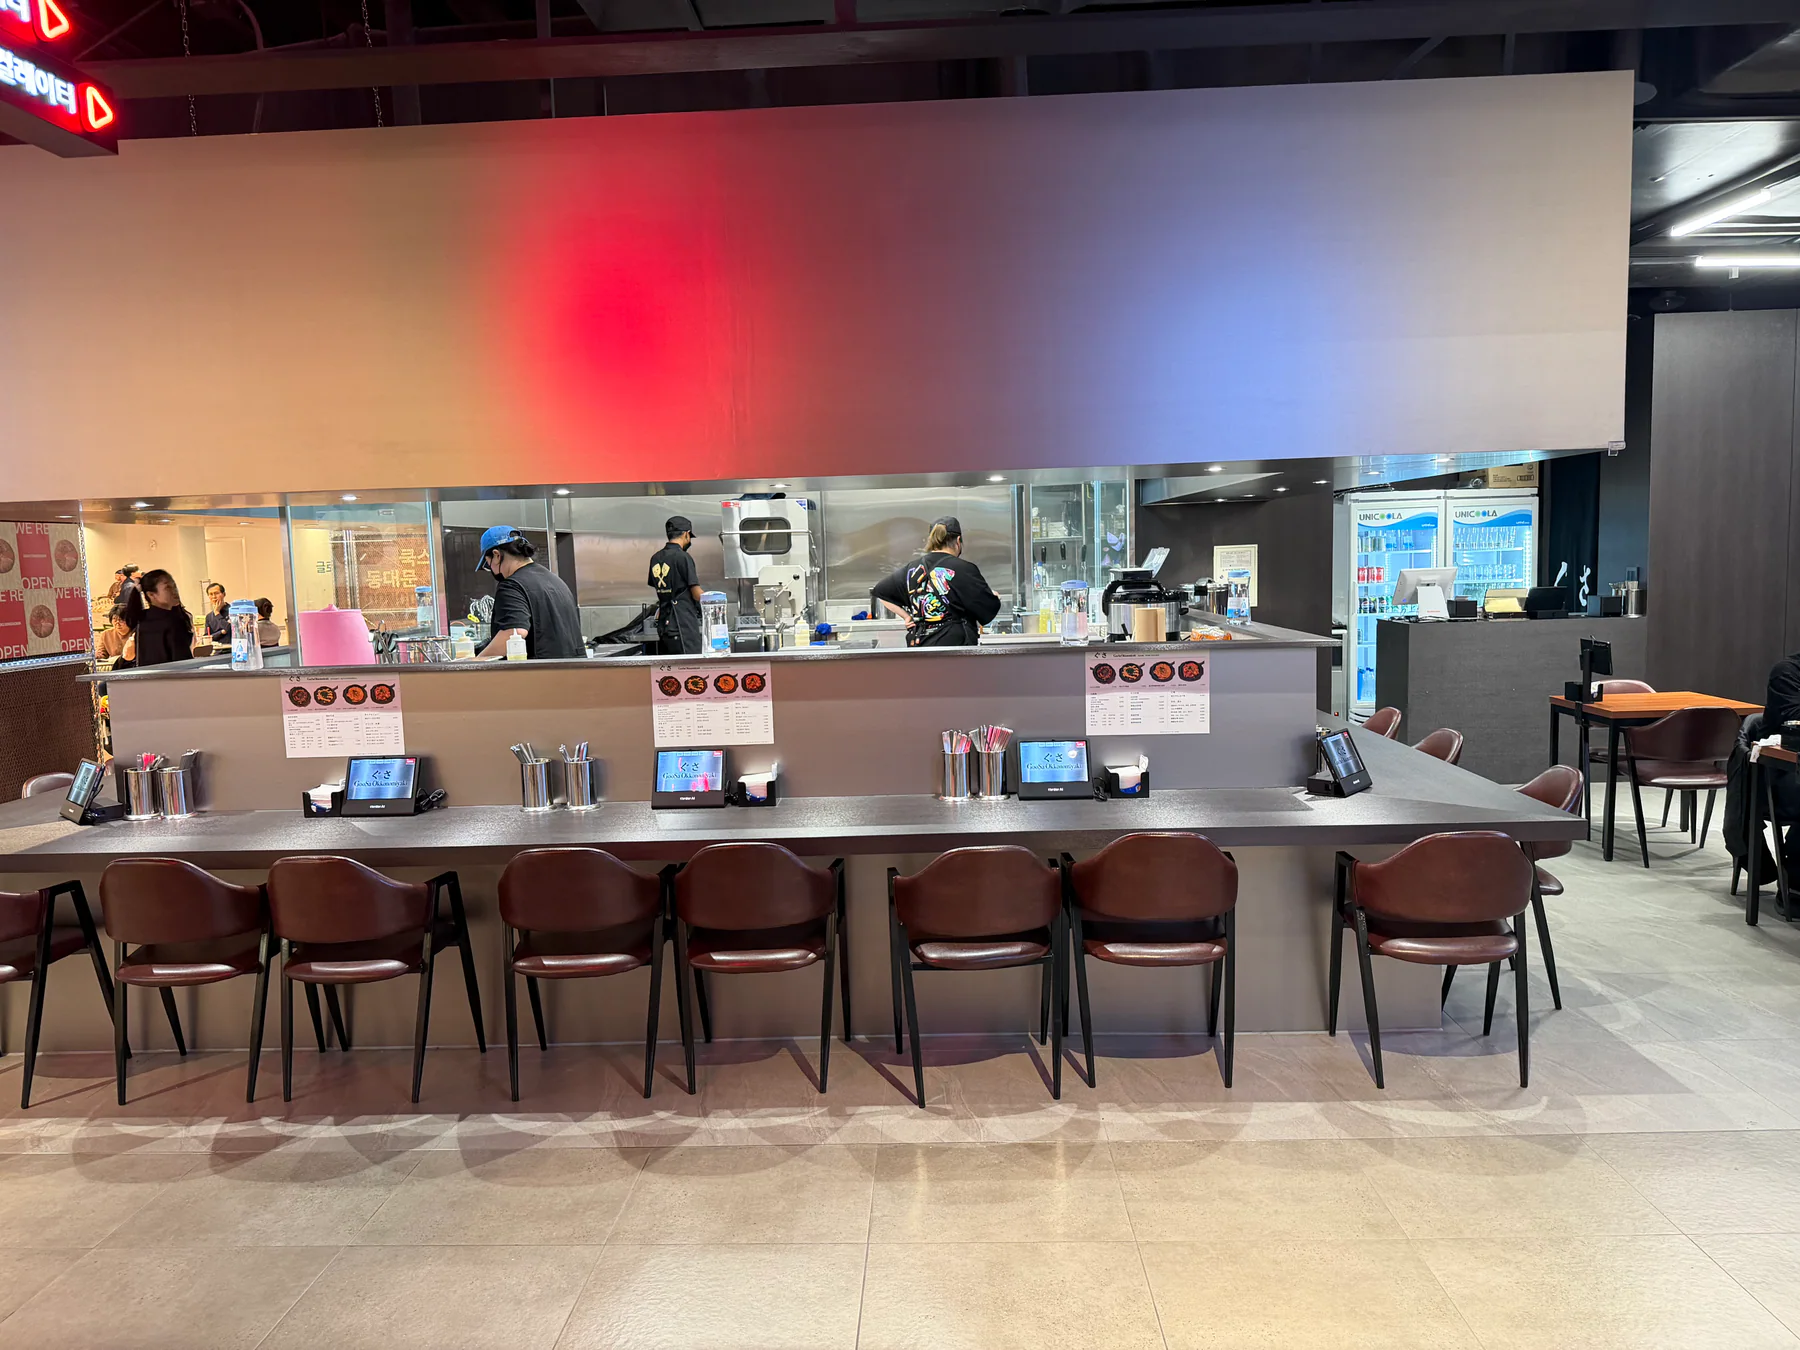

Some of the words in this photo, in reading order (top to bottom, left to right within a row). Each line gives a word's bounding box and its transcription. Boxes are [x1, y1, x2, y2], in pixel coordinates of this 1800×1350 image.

[21, 577, 54, 589] OPEN
[366, 570, 417, 590] 동대문
[60, 638, 92, 652] OPEN
[1044, 753, 1063, 762] ぐさ
[680, 762, 699, 772] ぐさ
[372, 770, 392, 780] ぐさ
